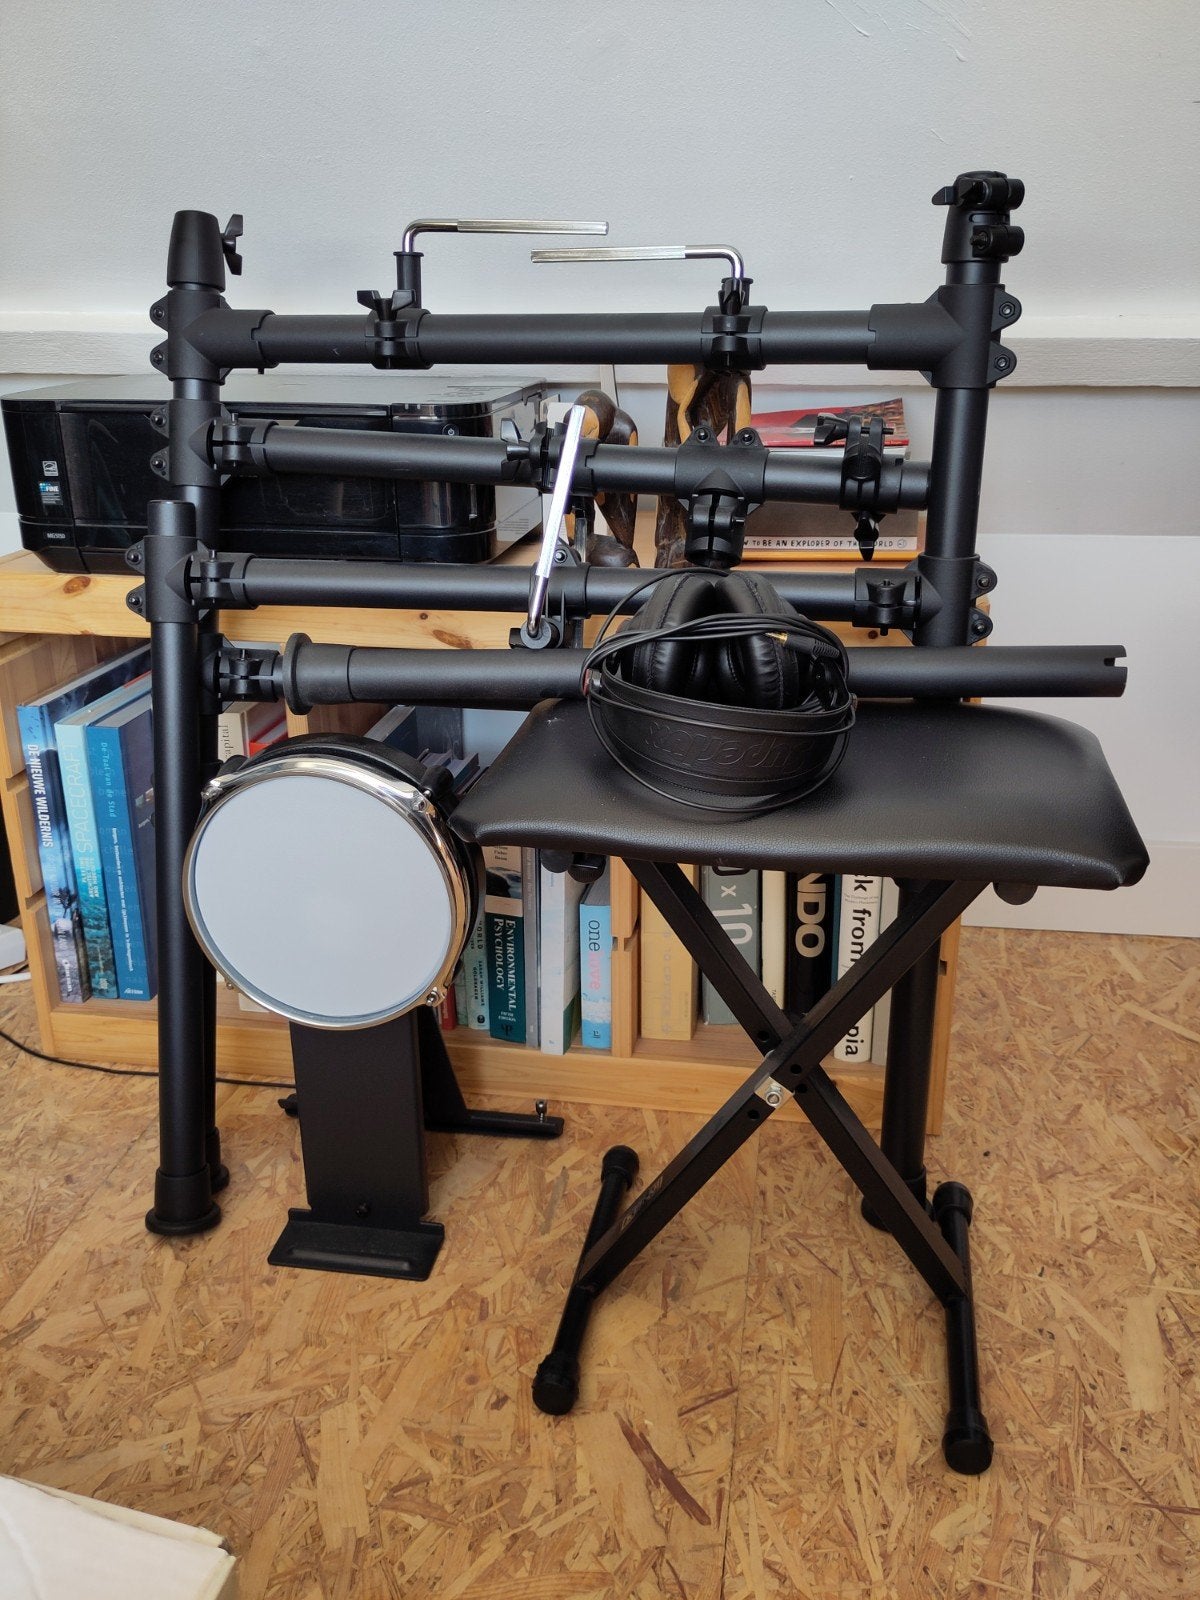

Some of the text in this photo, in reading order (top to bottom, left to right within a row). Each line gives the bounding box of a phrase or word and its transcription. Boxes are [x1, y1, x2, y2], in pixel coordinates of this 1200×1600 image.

[27, 744, 54, 848] DE NIEUWE WILDERNIS
[63, 744, 94, 853] SPACECRAFT
[493, 918, 505, 990] PSYCHOLOGY
[588, 920, 601, 952] one
[795, 871, 827, 958] NDO
[850, 908, 872, 963] from
[505, 919, 517, 1011] ENVIRONMENTAL
[845, 1026, 865, 1056] pia
